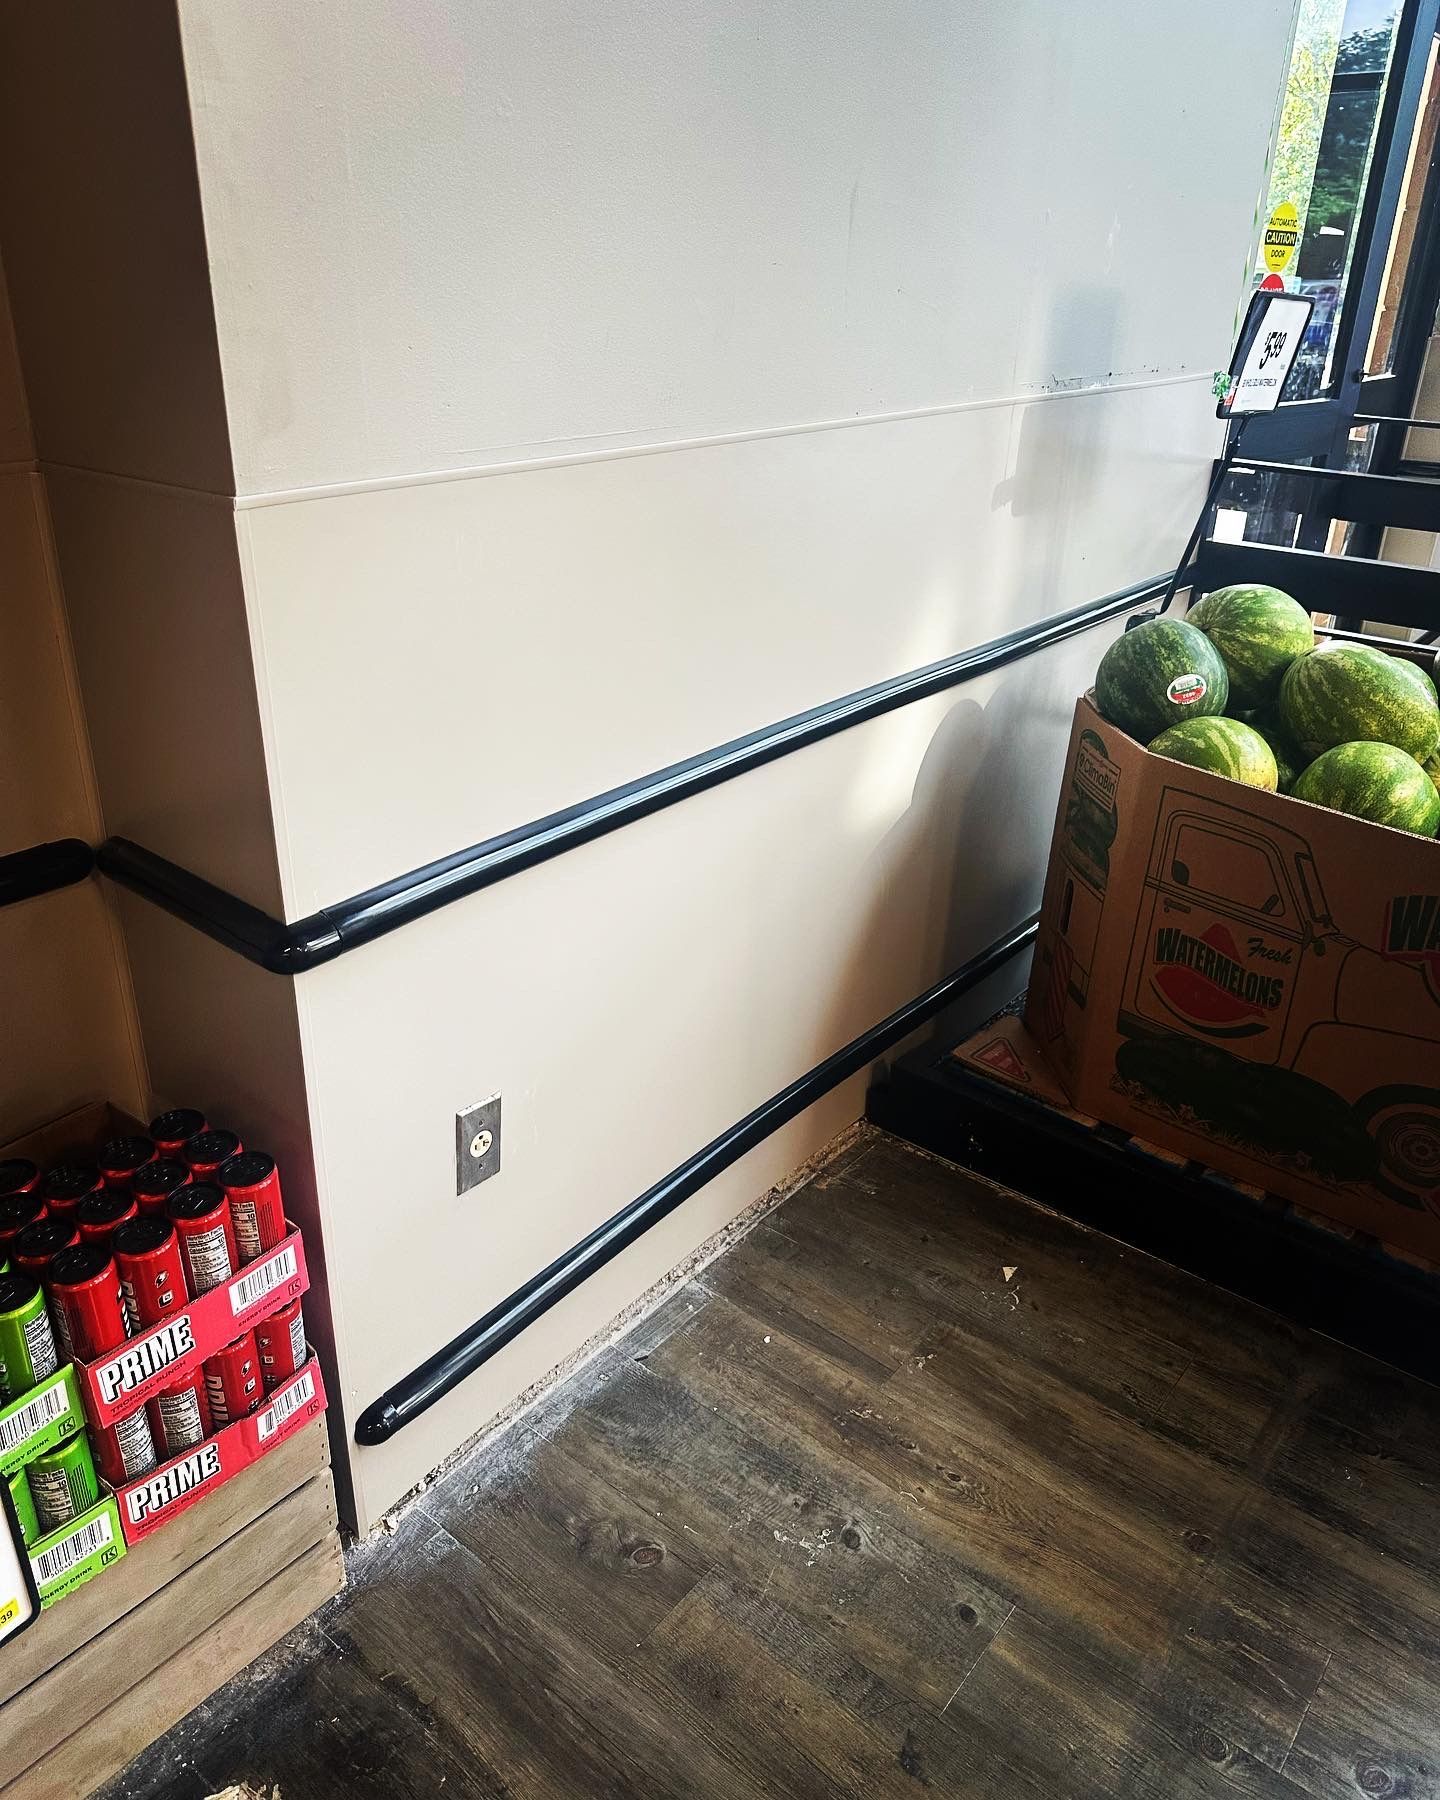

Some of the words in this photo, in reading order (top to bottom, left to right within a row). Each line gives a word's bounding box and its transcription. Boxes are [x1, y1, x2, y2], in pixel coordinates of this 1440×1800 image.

[1269, 217, 1298, 228] AUTOMATIC
[1266, 231, 1297, 245] CAUTION
[1270, 249, 1286, 258] DOOR
[1247, 936, 1293, 965] Fresh
[1155, 927, 1284, 1009] WATERMELONS
[98, 1317, 196, 1403] PRIME
[110, 1381, 156, 1414] TROPICAL
[156, 1360, 187, 1384] PUNCH
[26, 1437, 50, 1456] DRINK
[128, 1444, 221, 1523] PRIME
[135, 1502, 180, 1531] TROPICAL
[181, 1482, 212, 1504] PUNCH
[69, 1565, 93, 1584] DRINK
